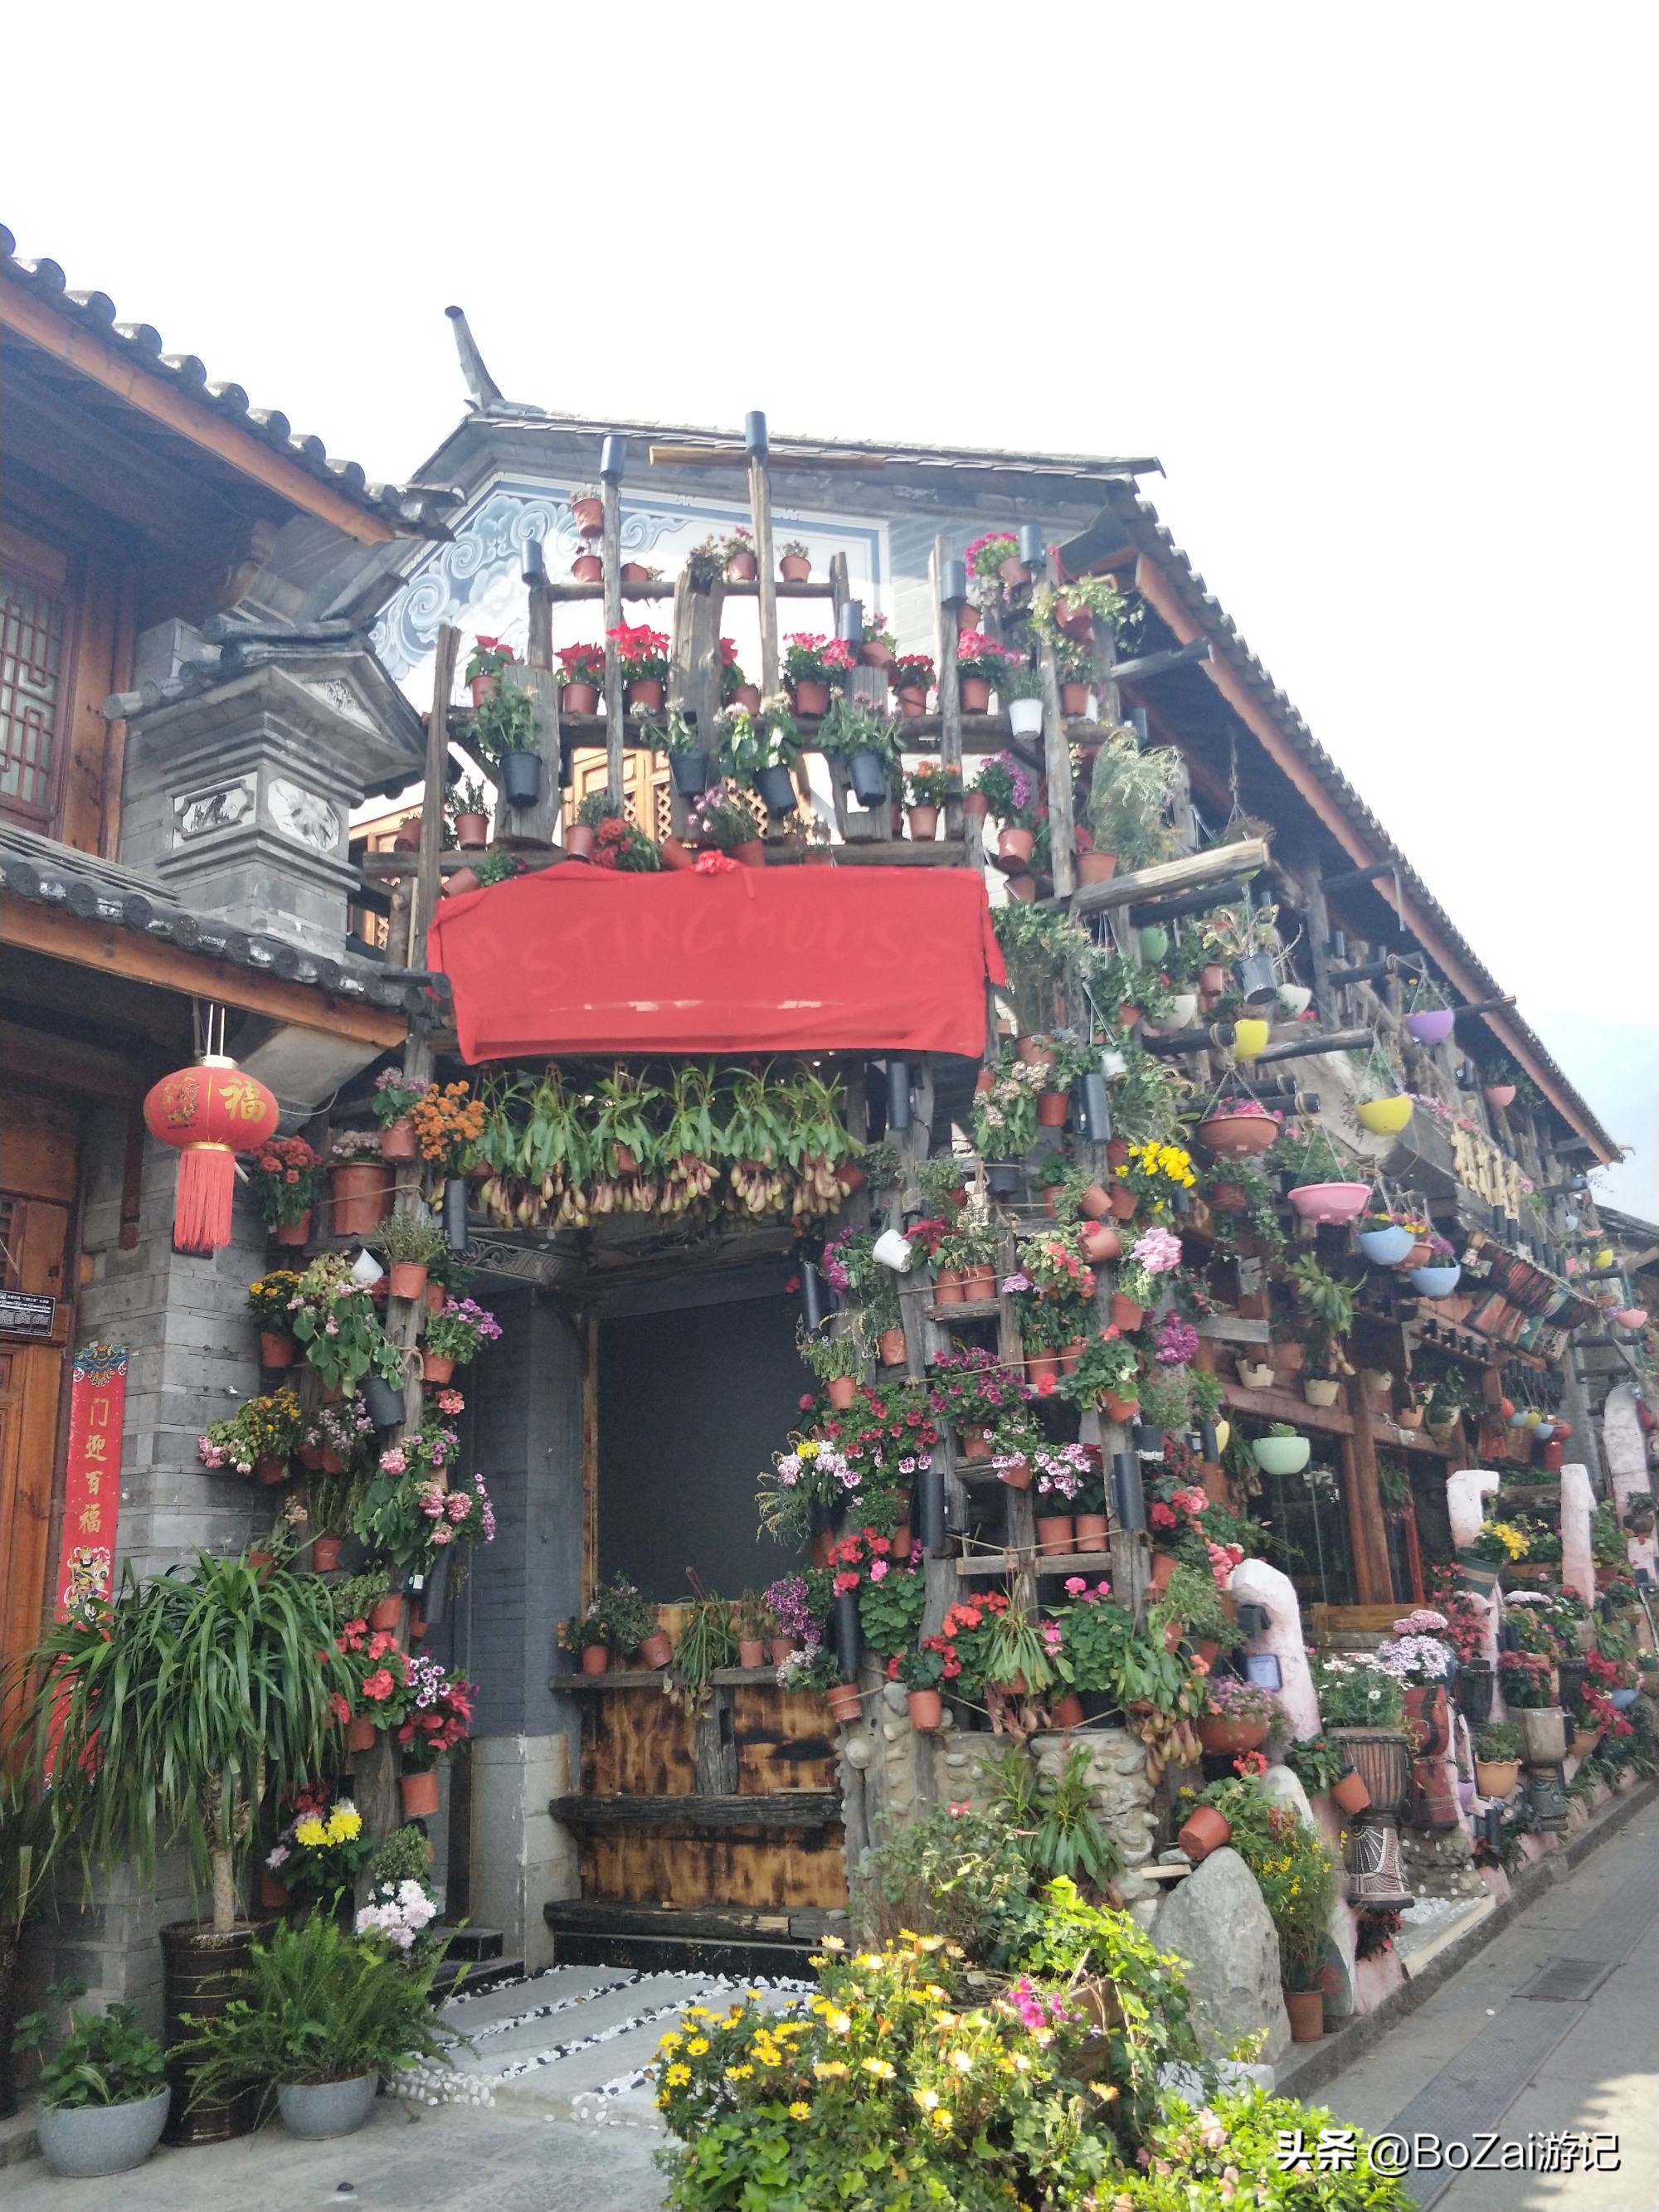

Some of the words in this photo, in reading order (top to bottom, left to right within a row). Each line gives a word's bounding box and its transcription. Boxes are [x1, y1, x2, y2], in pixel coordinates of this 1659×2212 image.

[218, 1078, 266, 1124] 福
[79, 1398, 109, 1534] 门迎百福
